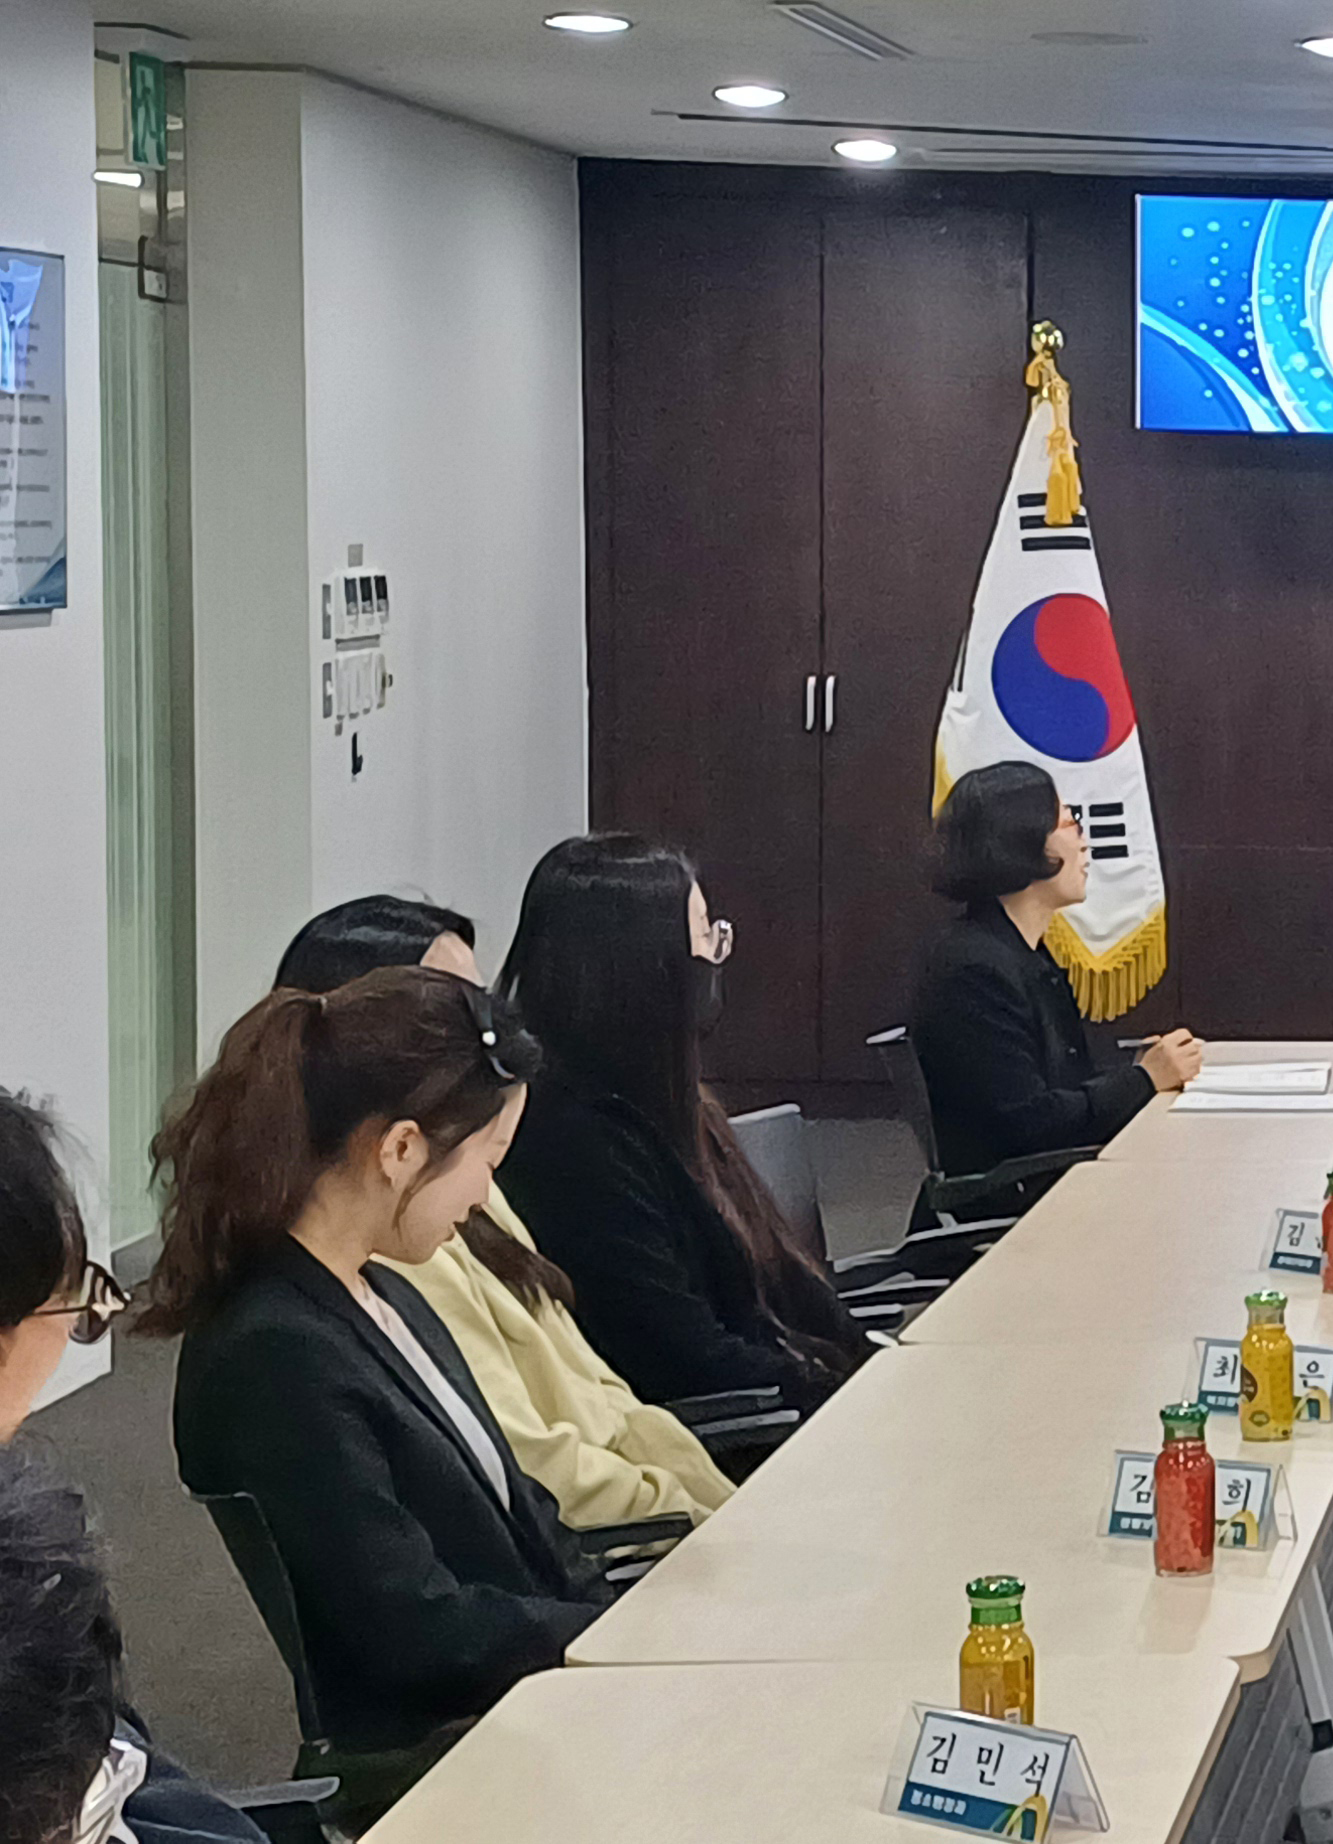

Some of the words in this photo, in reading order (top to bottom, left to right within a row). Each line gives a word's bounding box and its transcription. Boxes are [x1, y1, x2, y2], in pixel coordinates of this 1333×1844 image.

[1212, 1354, 1325, 1391] 최은
[1130, 1474, 1252, 1513] 김희
[926, 1732, 1050, 1798] 김민석
